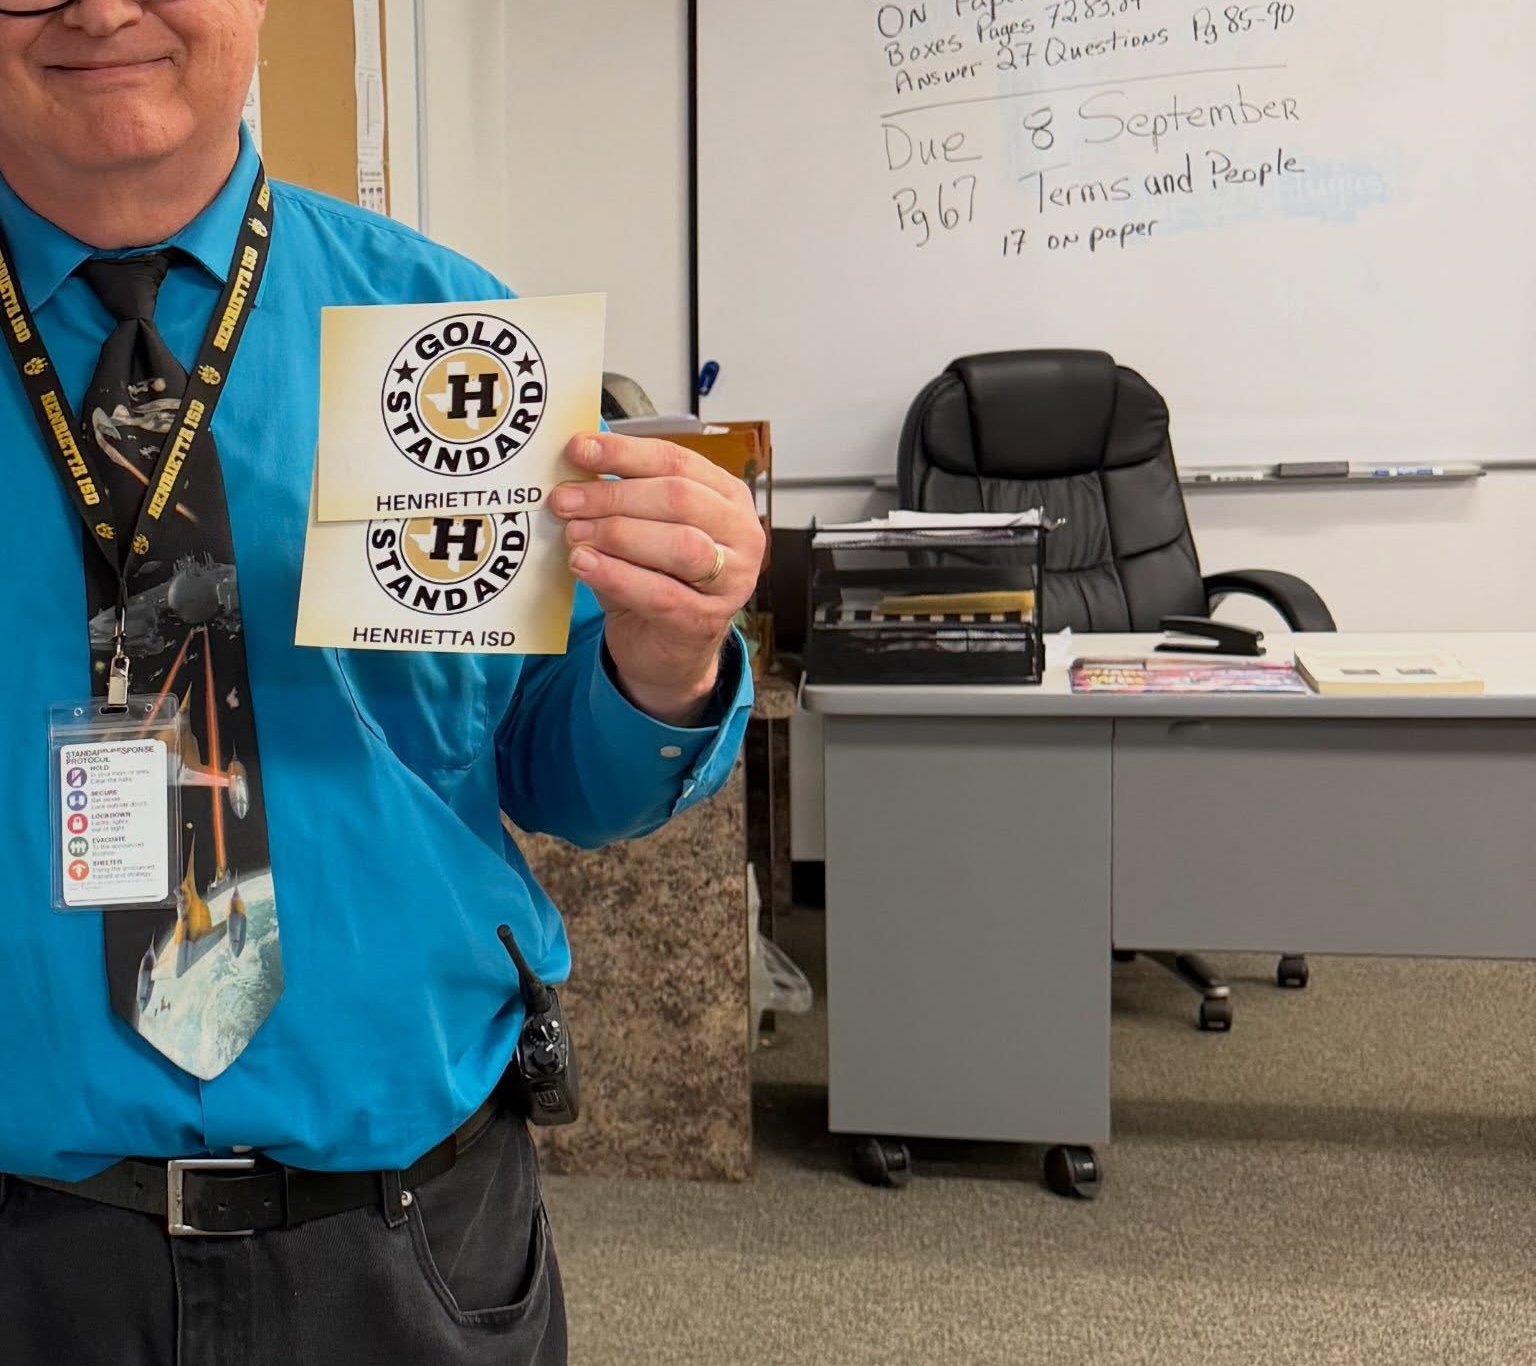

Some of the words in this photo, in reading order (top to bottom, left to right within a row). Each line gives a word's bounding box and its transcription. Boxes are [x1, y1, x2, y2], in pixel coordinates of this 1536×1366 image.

[884, 34, 963, 67] Boxes
[976, 11, 1035, 47] Pages
[996, 41, 1037, 70] 27
[1044, 28, 1169, 67] Questions
[1223, 1, 1295, 34] 85-90
[880, 123, 983, 171] Due
[1022, 106, 1054, 150] 8
[1017, 163, 1131, 214] Terms
[1144, 152, 1193, 197] and
[1205, 147, 1305, 190] People
[1003, 228, 1027, 256] 17
[1089, 219, 1160, 252] paper
[10, 313, 31, 344] ISD
[213, 267, 253, 352] HENRIETTA
[241, 245, 259, 268] ISD
[414, 320, 518, 363] GOLD
[447, 372, 499, 420] H
[40, 390, 88, 478] HENRIETTA
[76, 476, 101, 506] ISD
[386, 380, 544, 473] STANDARD
[147, 425, 195, 521] HENRIETTA
[183, 399, 205, 430] ISD
[376, 490, 501, 512] HENRIETTA
[507, 487, 542, 505] ISD
[429, 517, 484, 562] H
[371, 527, 525, 613] STANDARD
[352, 626, 475, 647] HENRIETTA
[480, 629, 516, 647] ISD
